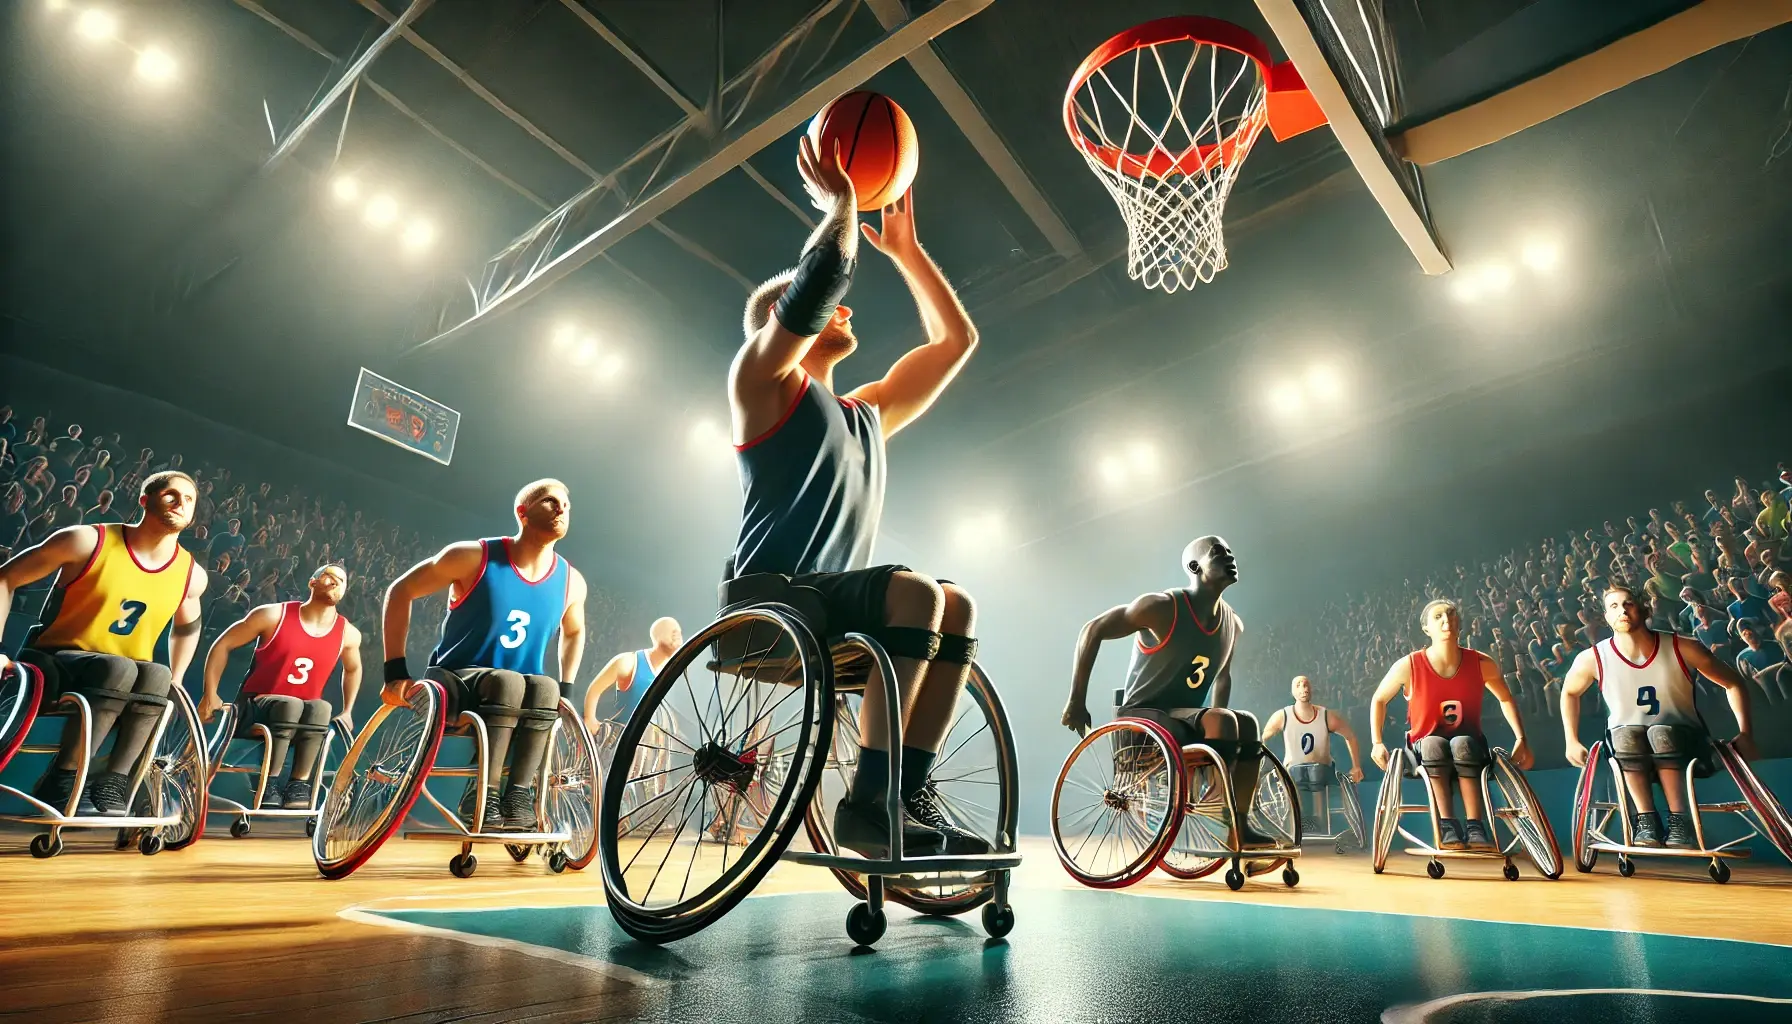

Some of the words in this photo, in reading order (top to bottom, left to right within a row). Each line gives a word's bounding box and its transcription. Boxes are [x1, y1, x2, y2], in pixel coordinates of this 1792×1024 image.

[499, 609, 531, 649] 3
[287, 657, 314, 685] 3
[1186, 655, 1210, 689] 3
